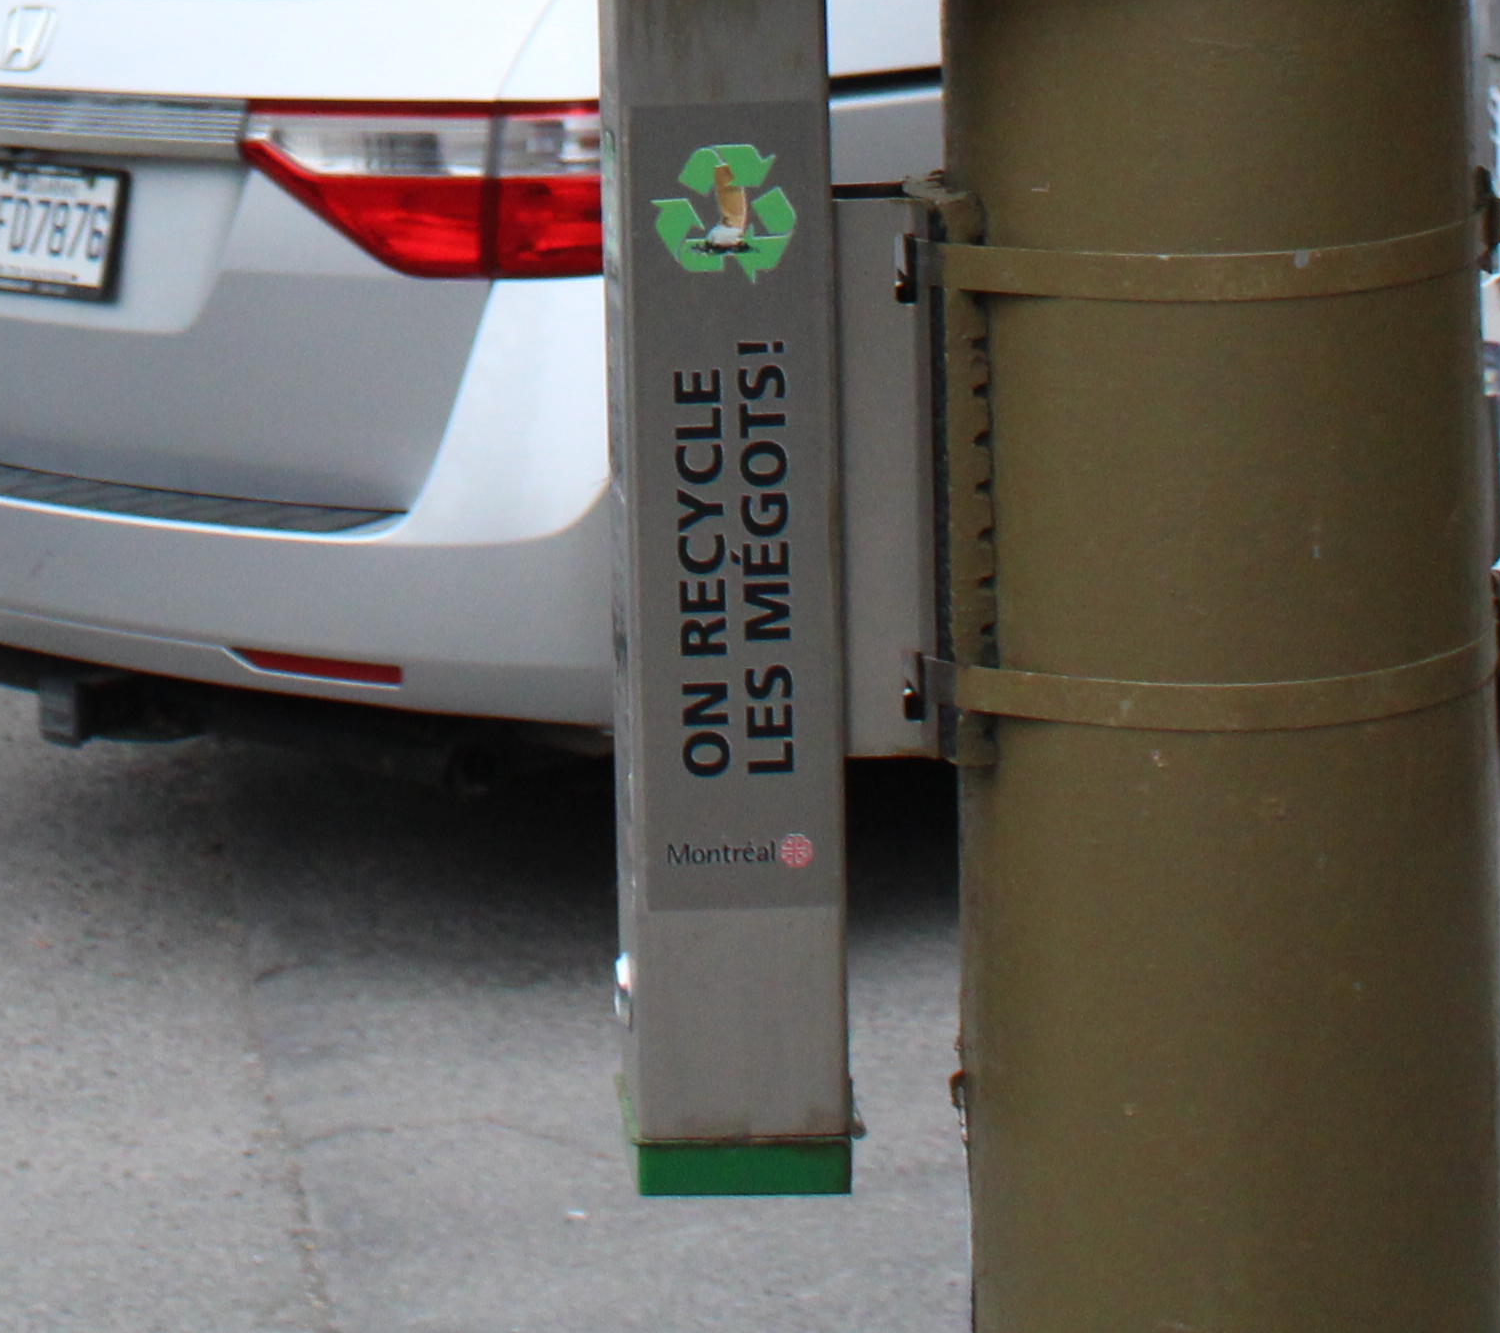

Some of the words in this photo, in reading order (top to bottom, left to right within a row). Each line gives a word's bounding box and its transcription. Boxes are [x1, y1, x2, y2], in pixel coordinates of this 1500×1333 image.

[674, 369, 728, 656] RECYCLE
[731, 340, 792, 641] MÉGOTS!
[682, 682, 731, 778] ON
[744, 663, 795, 774] LES
[667, 839, 775, 864] Montréal
